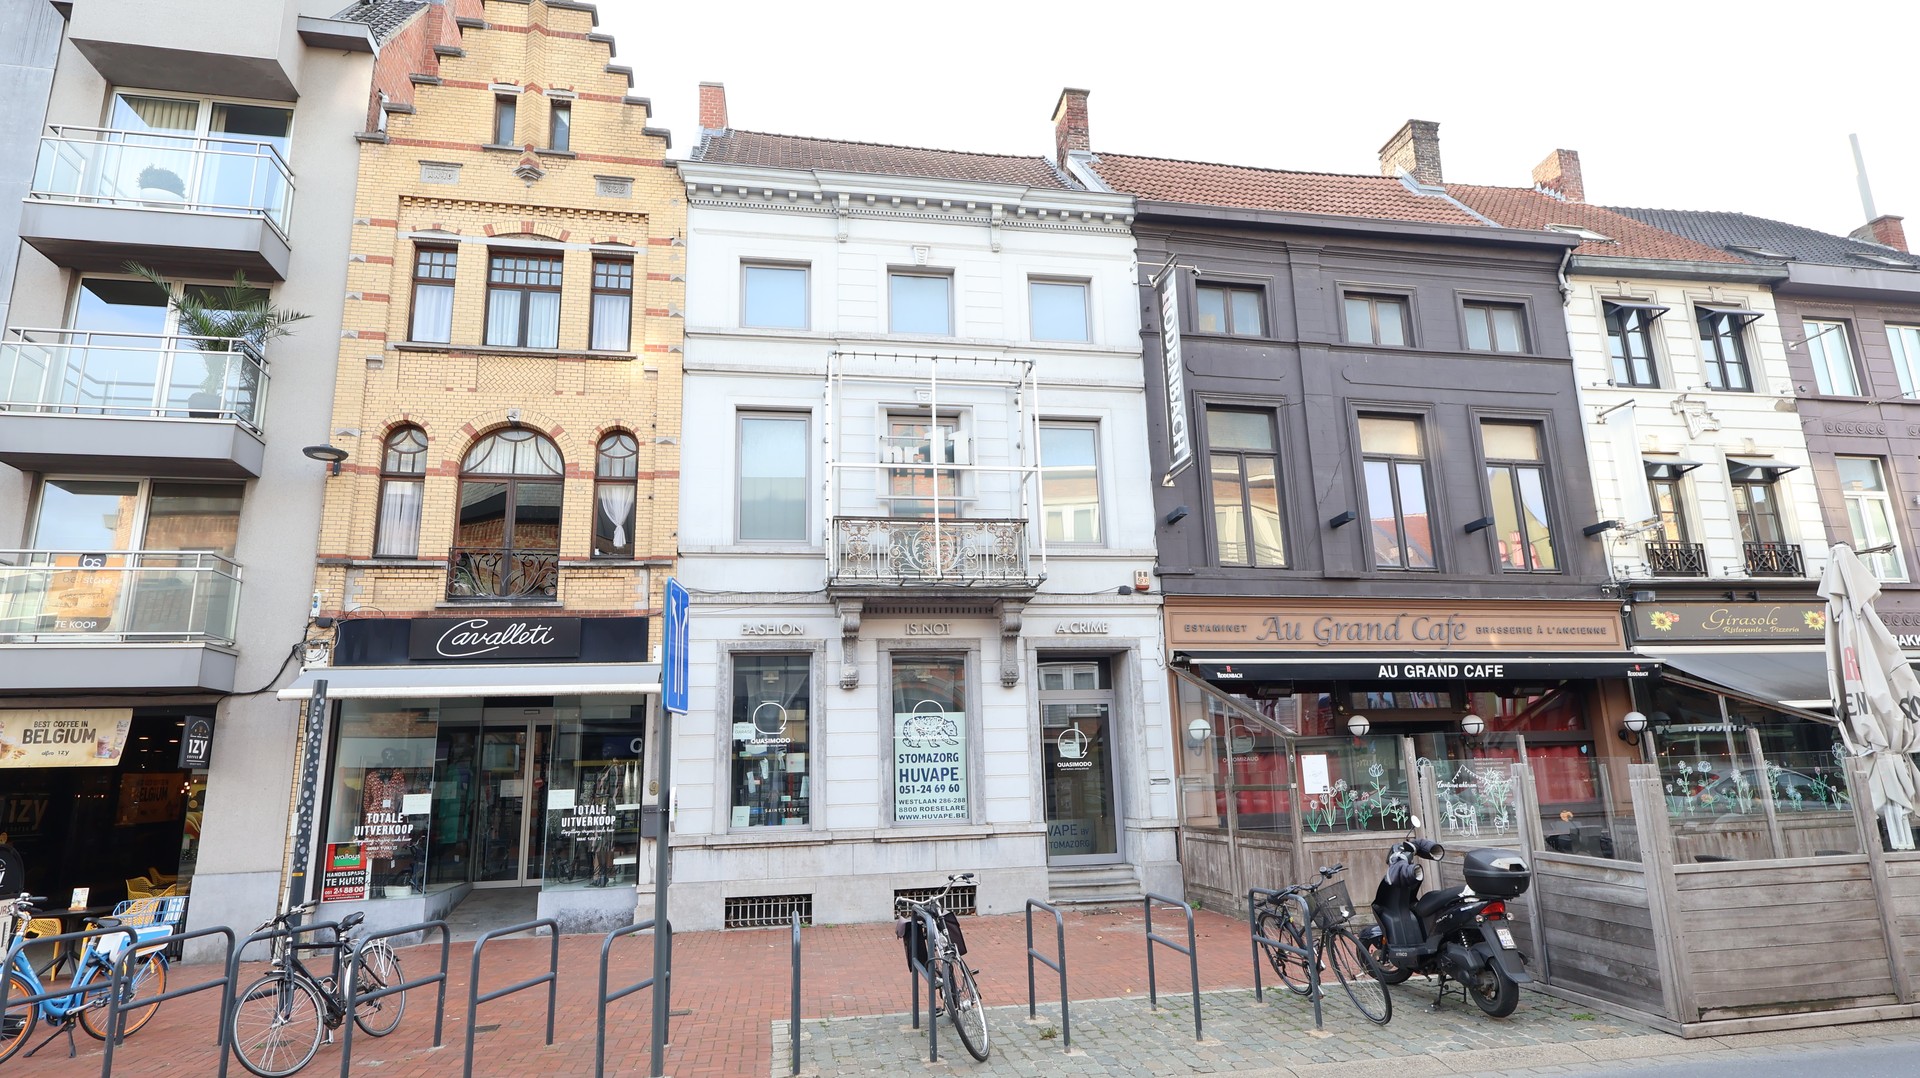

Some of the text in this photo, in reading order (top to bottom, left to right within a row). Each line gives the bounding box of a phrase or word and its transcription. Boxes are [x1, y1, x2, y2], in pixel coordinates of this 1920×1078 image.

[602, 185, 626, 195] 1922
[1701, 606, 1781, 630] Girasole
[55, 620, 97, 629] TE KOOP
[740, 623, 804, 636] FASHION
[905, 623, 951, 635] IS NOT
[1056, 622, 1110, 635] A CRIME
[1184, 624, 1247, 633] ESTAMINET
[1256, 615, 1303, 641] Au
[1313, 612, 1408, 646] Grand
[1475, 625, 1532, 635] BRASSERIE
[1547, 625, 1607, 635] L'ANCIENNE
[1722, 626, 1762, 634] Ristorante
[435, 618, 554, 657] Cavalleti
[1378, 664, 1504, 678] AU GRAND CAFE
[22, 728, 96, 744] BELGIUM
[898, 752, 959, 764] STOMAZORG
[899, 767, 959, 783] HUVAPE
[899, 783, 960, 794] 051-24 69 60
[573, 804, 607, 816] TOTALE
[898, 812, 966, 820] WWW.HUVAPE.BE
[366, 812, 404, 824] TOTALE
[561, 815, 616, 828] UITVERKOOP
[354, 824, 414, 837] UITVERKOOP
[326, 876, 365, 887] TE HUUR
